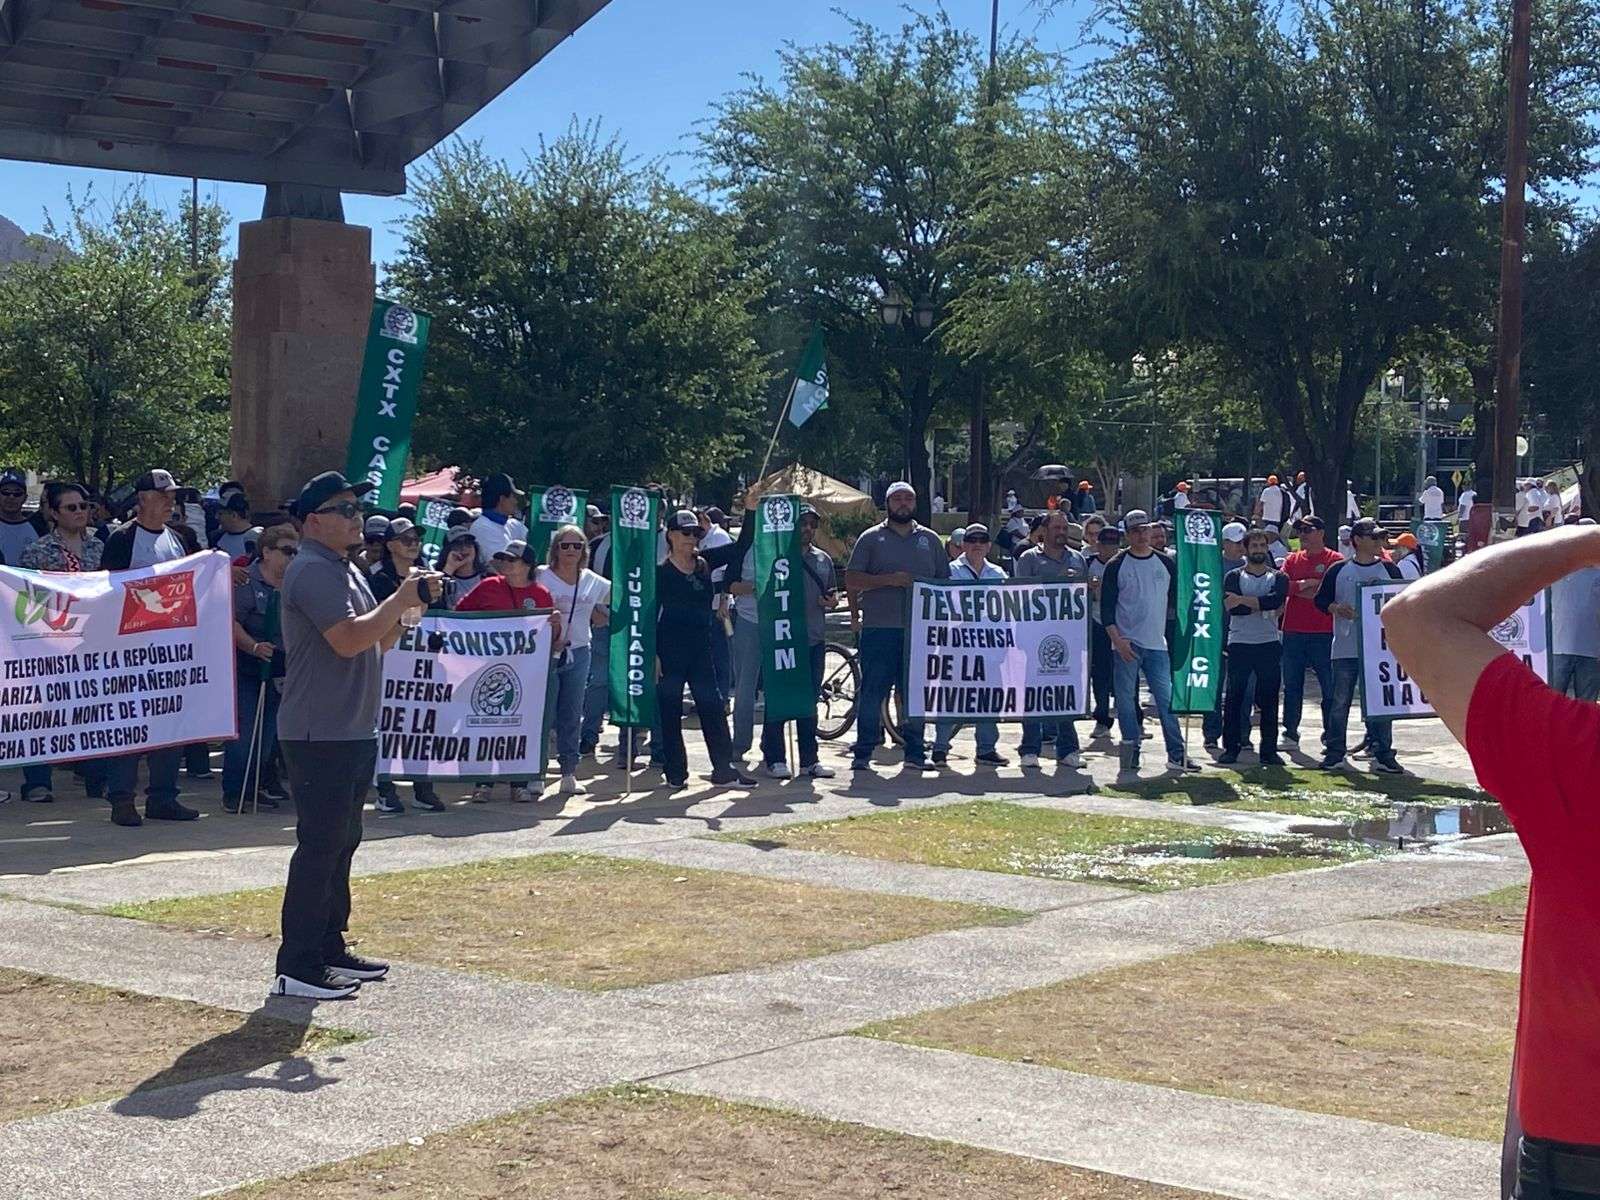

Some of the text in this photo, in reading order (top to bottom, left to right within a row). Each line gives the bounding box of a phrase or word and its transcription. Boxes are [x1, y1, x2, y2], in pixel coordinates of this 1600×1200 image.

[377, 348, 405, 418] CXTX
[774, 558, 797, 671] STRM
[920, 587, 1085, 622] TELEFONISTAS
[628, 567, 645, 696] JUBILADOS
[927, 626, 1015, 648] EN DEFENSA
[1187, 572, 1212, 688] CXTX CM
[4, 643, 193, 680] TELEFONISTA DE LA REPÚBLICA
[413, 659, 433, 679] EN
[926, 654, 985, 681] DE LA
[47, 681, 71, 702] CON
[75, 678, 98, 699] LOS
[103, 669, 187, 696] COMPAÑEROS
[190, 666, 208, 685] DEL
[384, 679, 454, 703] DEFENSA
[923, 685, 1077, 713] VIVIENDA DIGNA
[1, 694, 183, 734] NACIONAL MONTE DE PIEDAD
[380, 706, 437, 734] DE LA
[30, 736, 46, 757] DE
[50, 732, 75, 754] SUS
[80, 725, 149, 751] DERECHOS
[380, 734, 527, 762] VIVIENDA DIGNA
